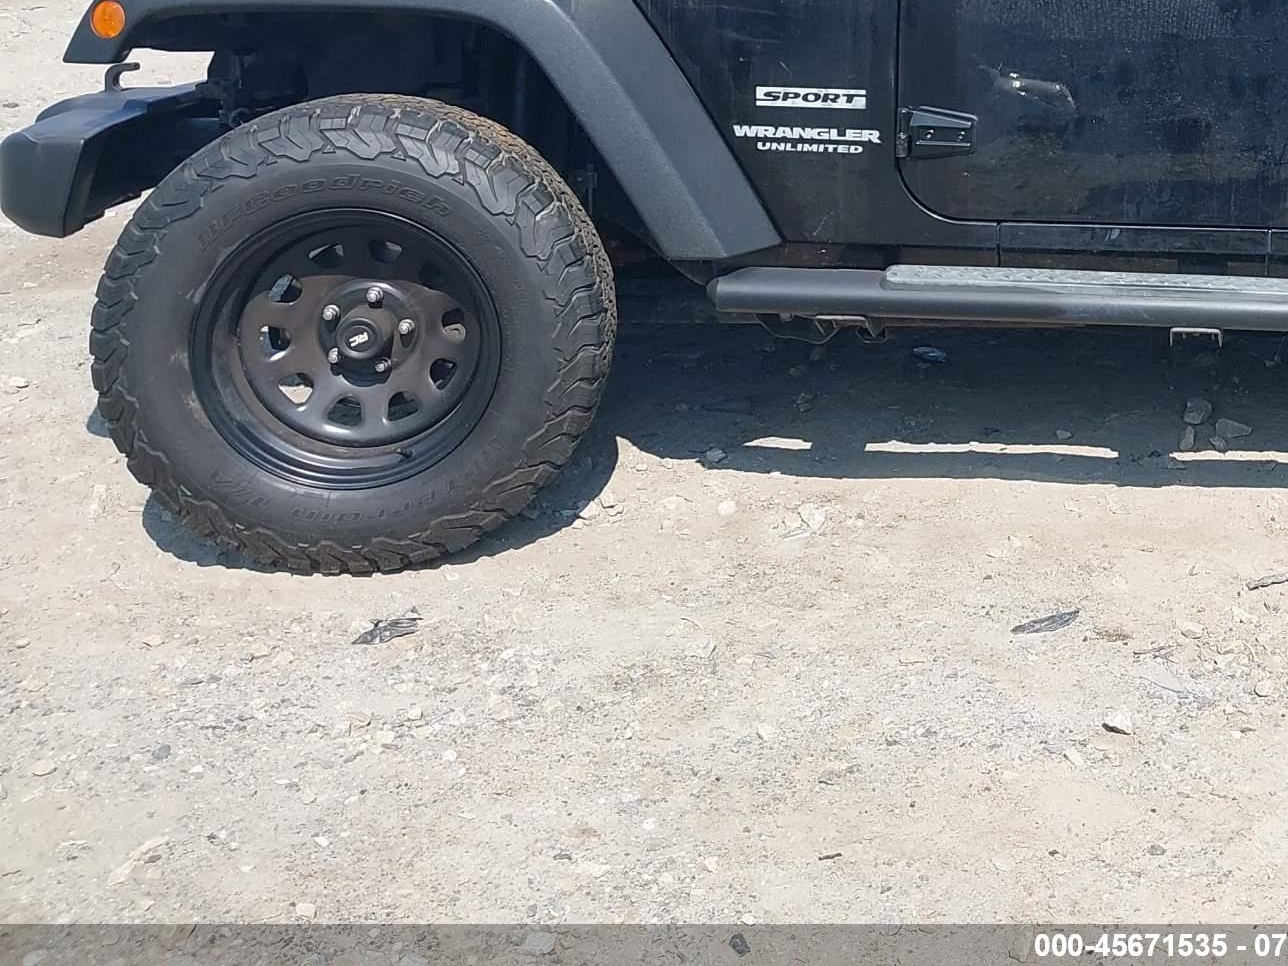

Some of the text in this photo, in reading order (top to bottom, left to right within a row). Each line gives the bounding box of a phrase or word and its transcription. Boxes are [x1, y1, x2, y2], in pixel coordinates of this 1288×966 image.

[760, 89, 864, 104] SPORT
[732, 124, 882, 144] WRANGLER
[756, 141, 864, 154] UNLIMITED
